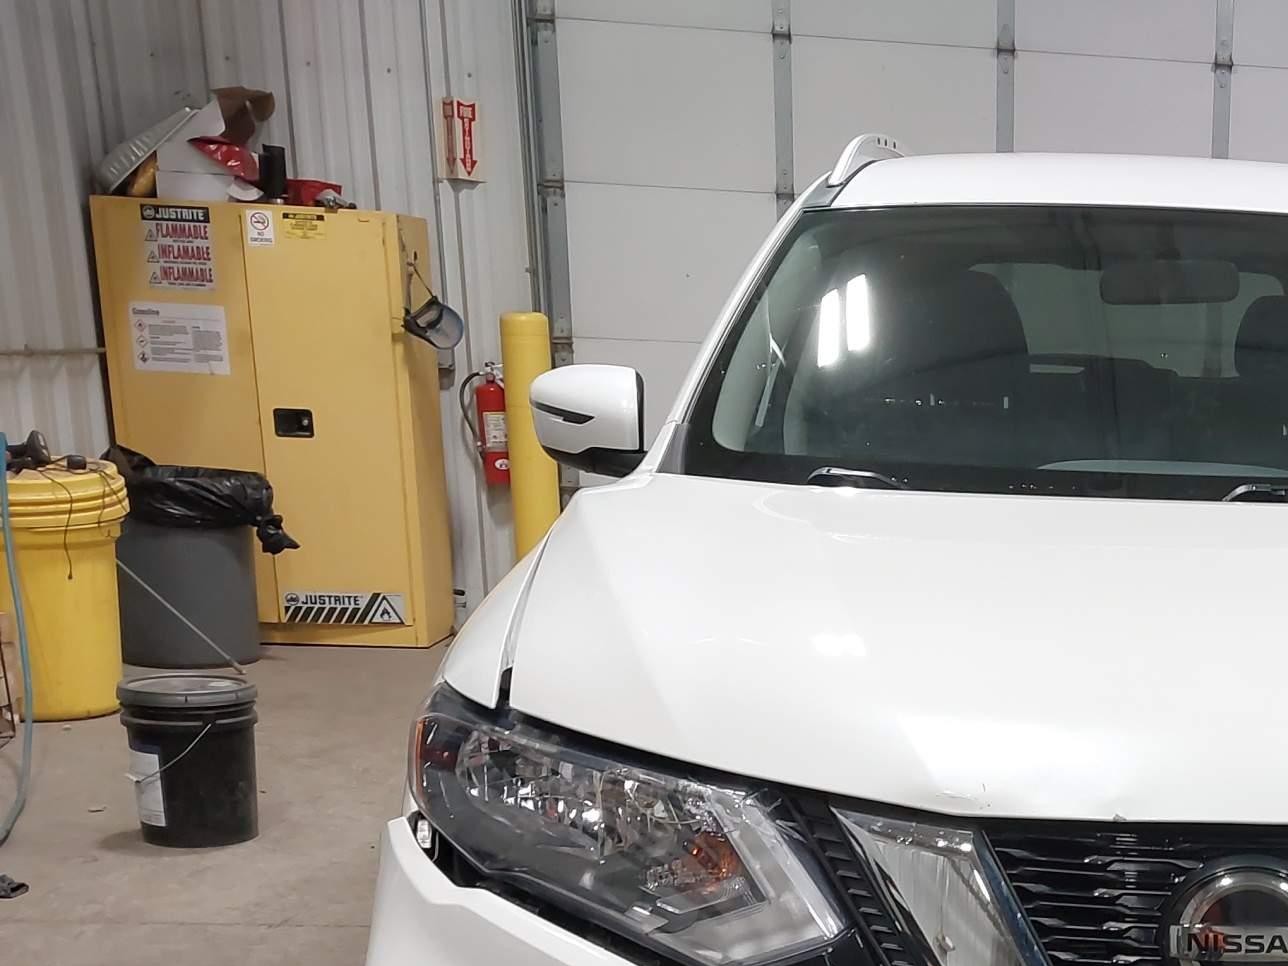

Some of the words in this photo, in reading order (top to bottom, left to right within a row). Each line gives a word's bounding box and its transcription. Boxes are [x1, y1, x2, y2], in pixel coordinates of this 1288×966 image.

[155, 207, 205, 220] JUSTRITE
[155, 222, 209, 240] FLAMMABLE
[158, 244, 211, 262] INFLAMABLE
[160, 265, 214, 283] INFLAMMABLE
[301, 594, 361, 606] JUSTRITE
